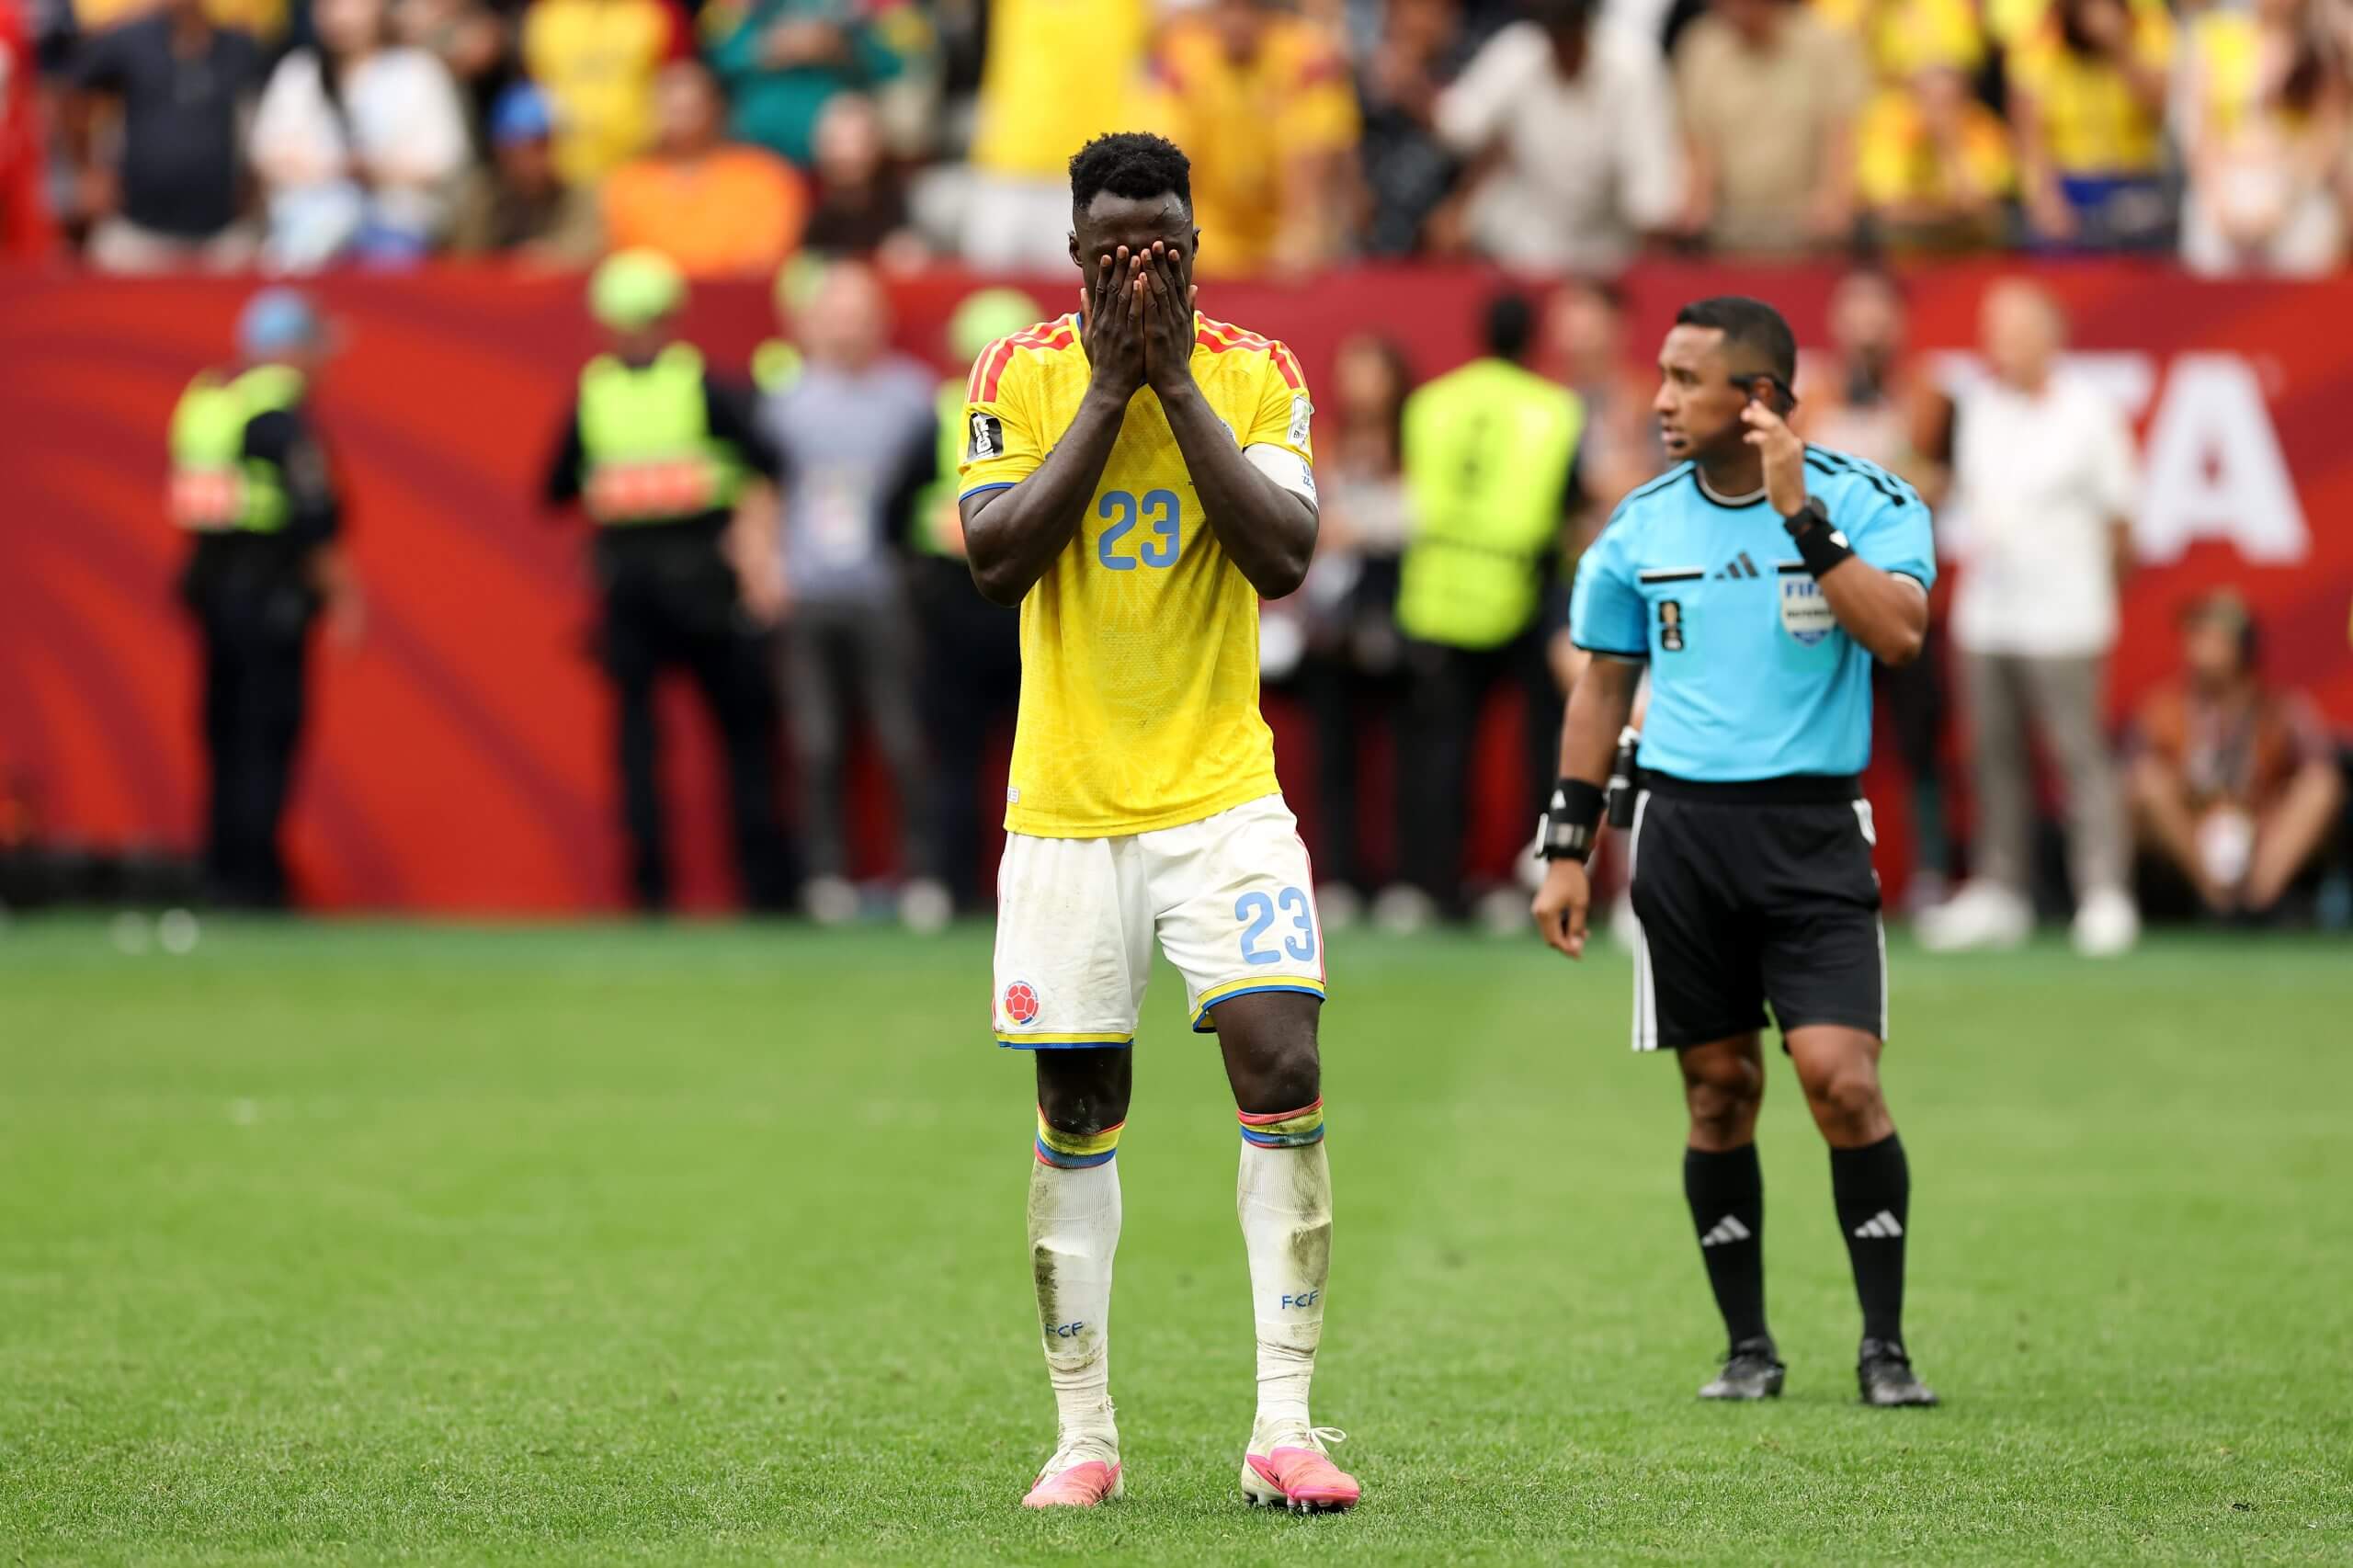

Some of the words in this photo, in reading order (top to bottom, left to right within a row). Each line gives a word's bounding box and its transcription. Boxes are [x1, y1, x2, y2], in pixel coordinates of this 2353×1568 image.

[1097, 489, 1180, 570] 23
[1786, 581, 1824, 597] FIF
[1234, 886, 1315, 965] 23
[1281, 1289, 1319, 1310] FCF
[1045, 1321, 1084, 1337] FCF
